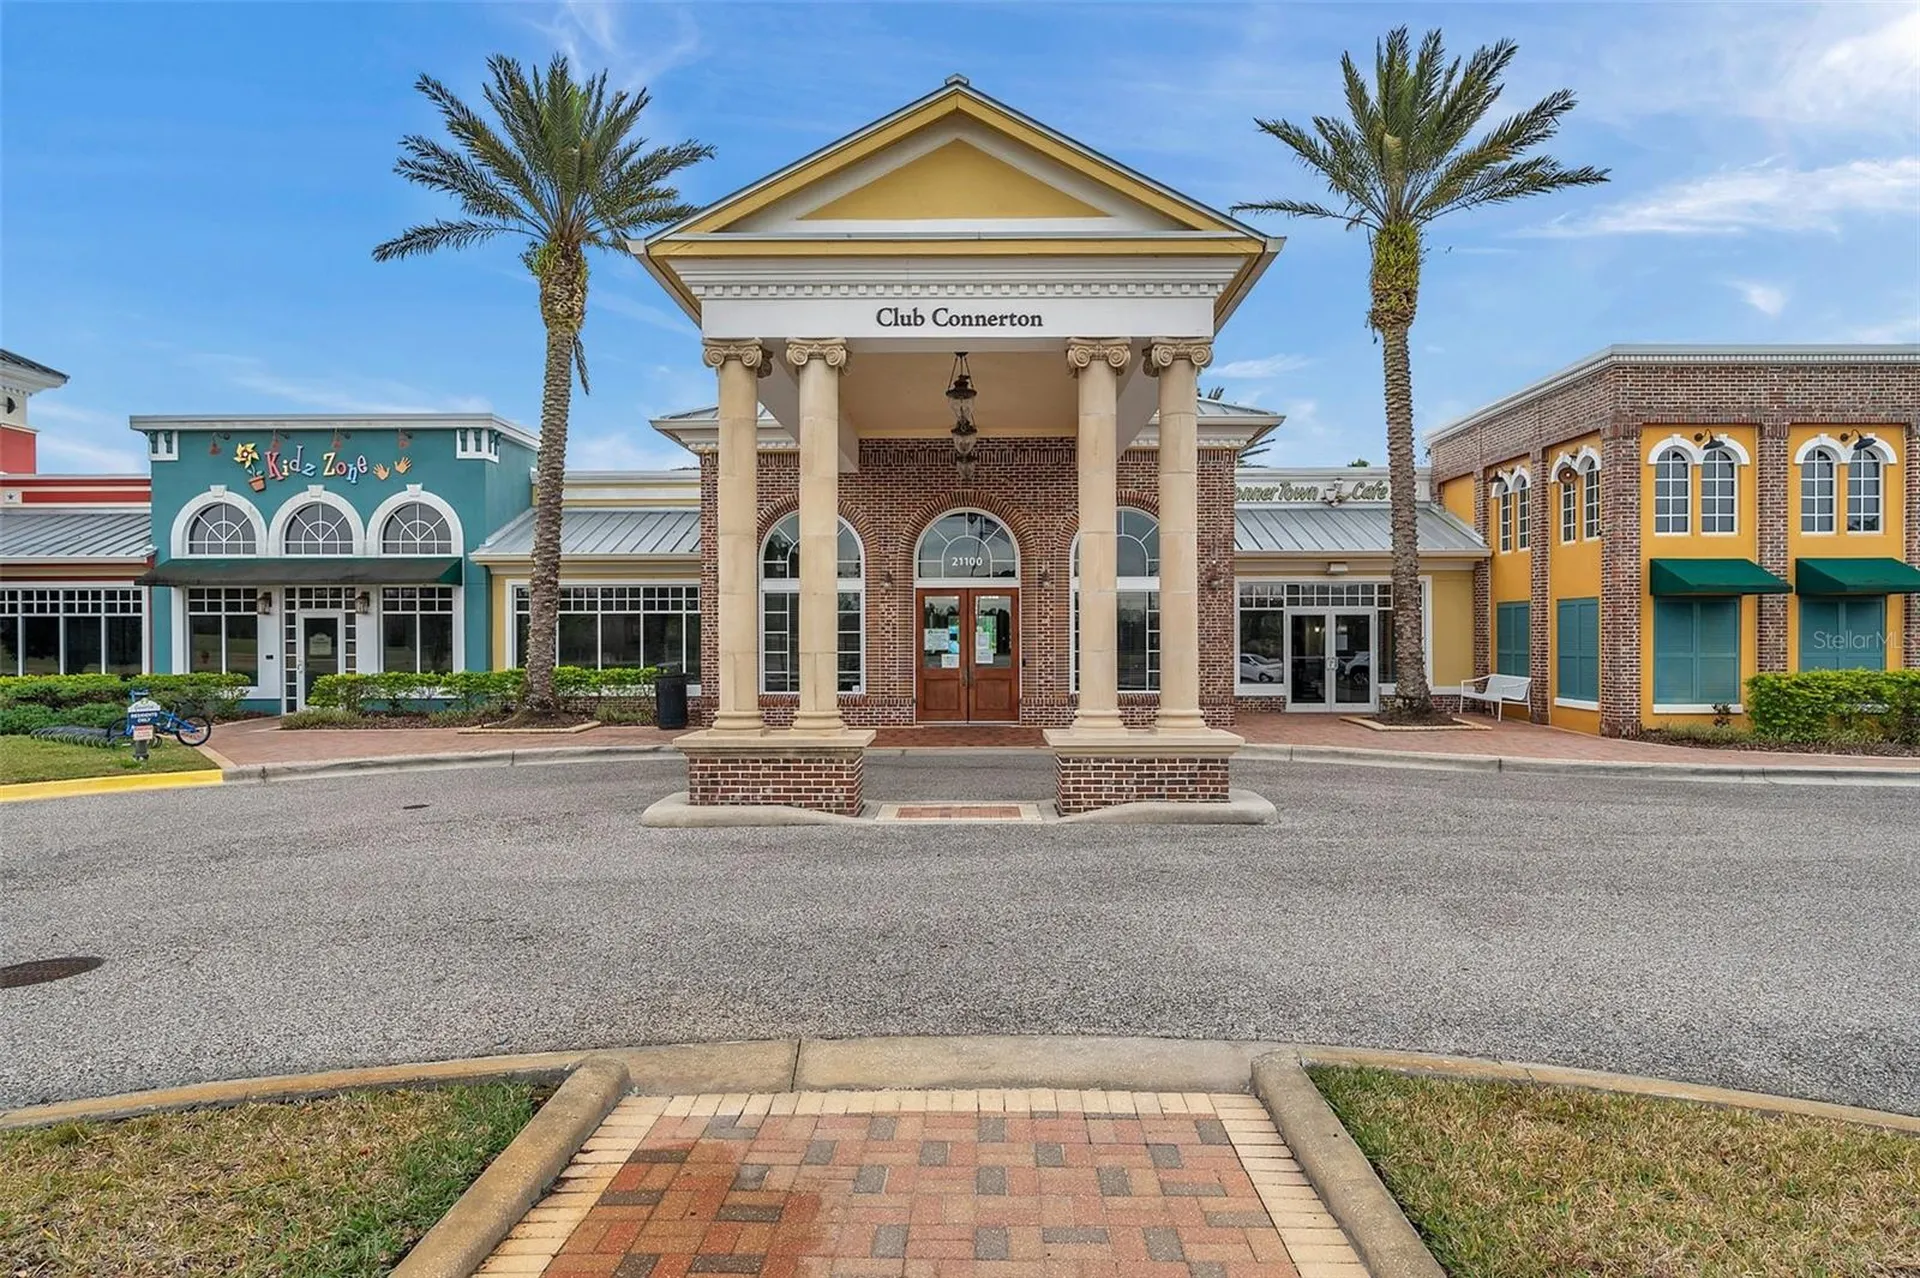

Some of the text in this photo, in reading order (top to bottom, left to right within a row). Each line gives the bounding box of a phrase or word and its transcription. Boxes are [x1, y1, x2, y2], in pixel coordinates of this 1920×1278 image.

[876, 307, 1043, 327] Club Connerton
[264, 445, 368, 483] Kidz Zone
[1234, 480, 1389, 501] onnerTown Cafe
[952, 556, 983, 567] 21100
